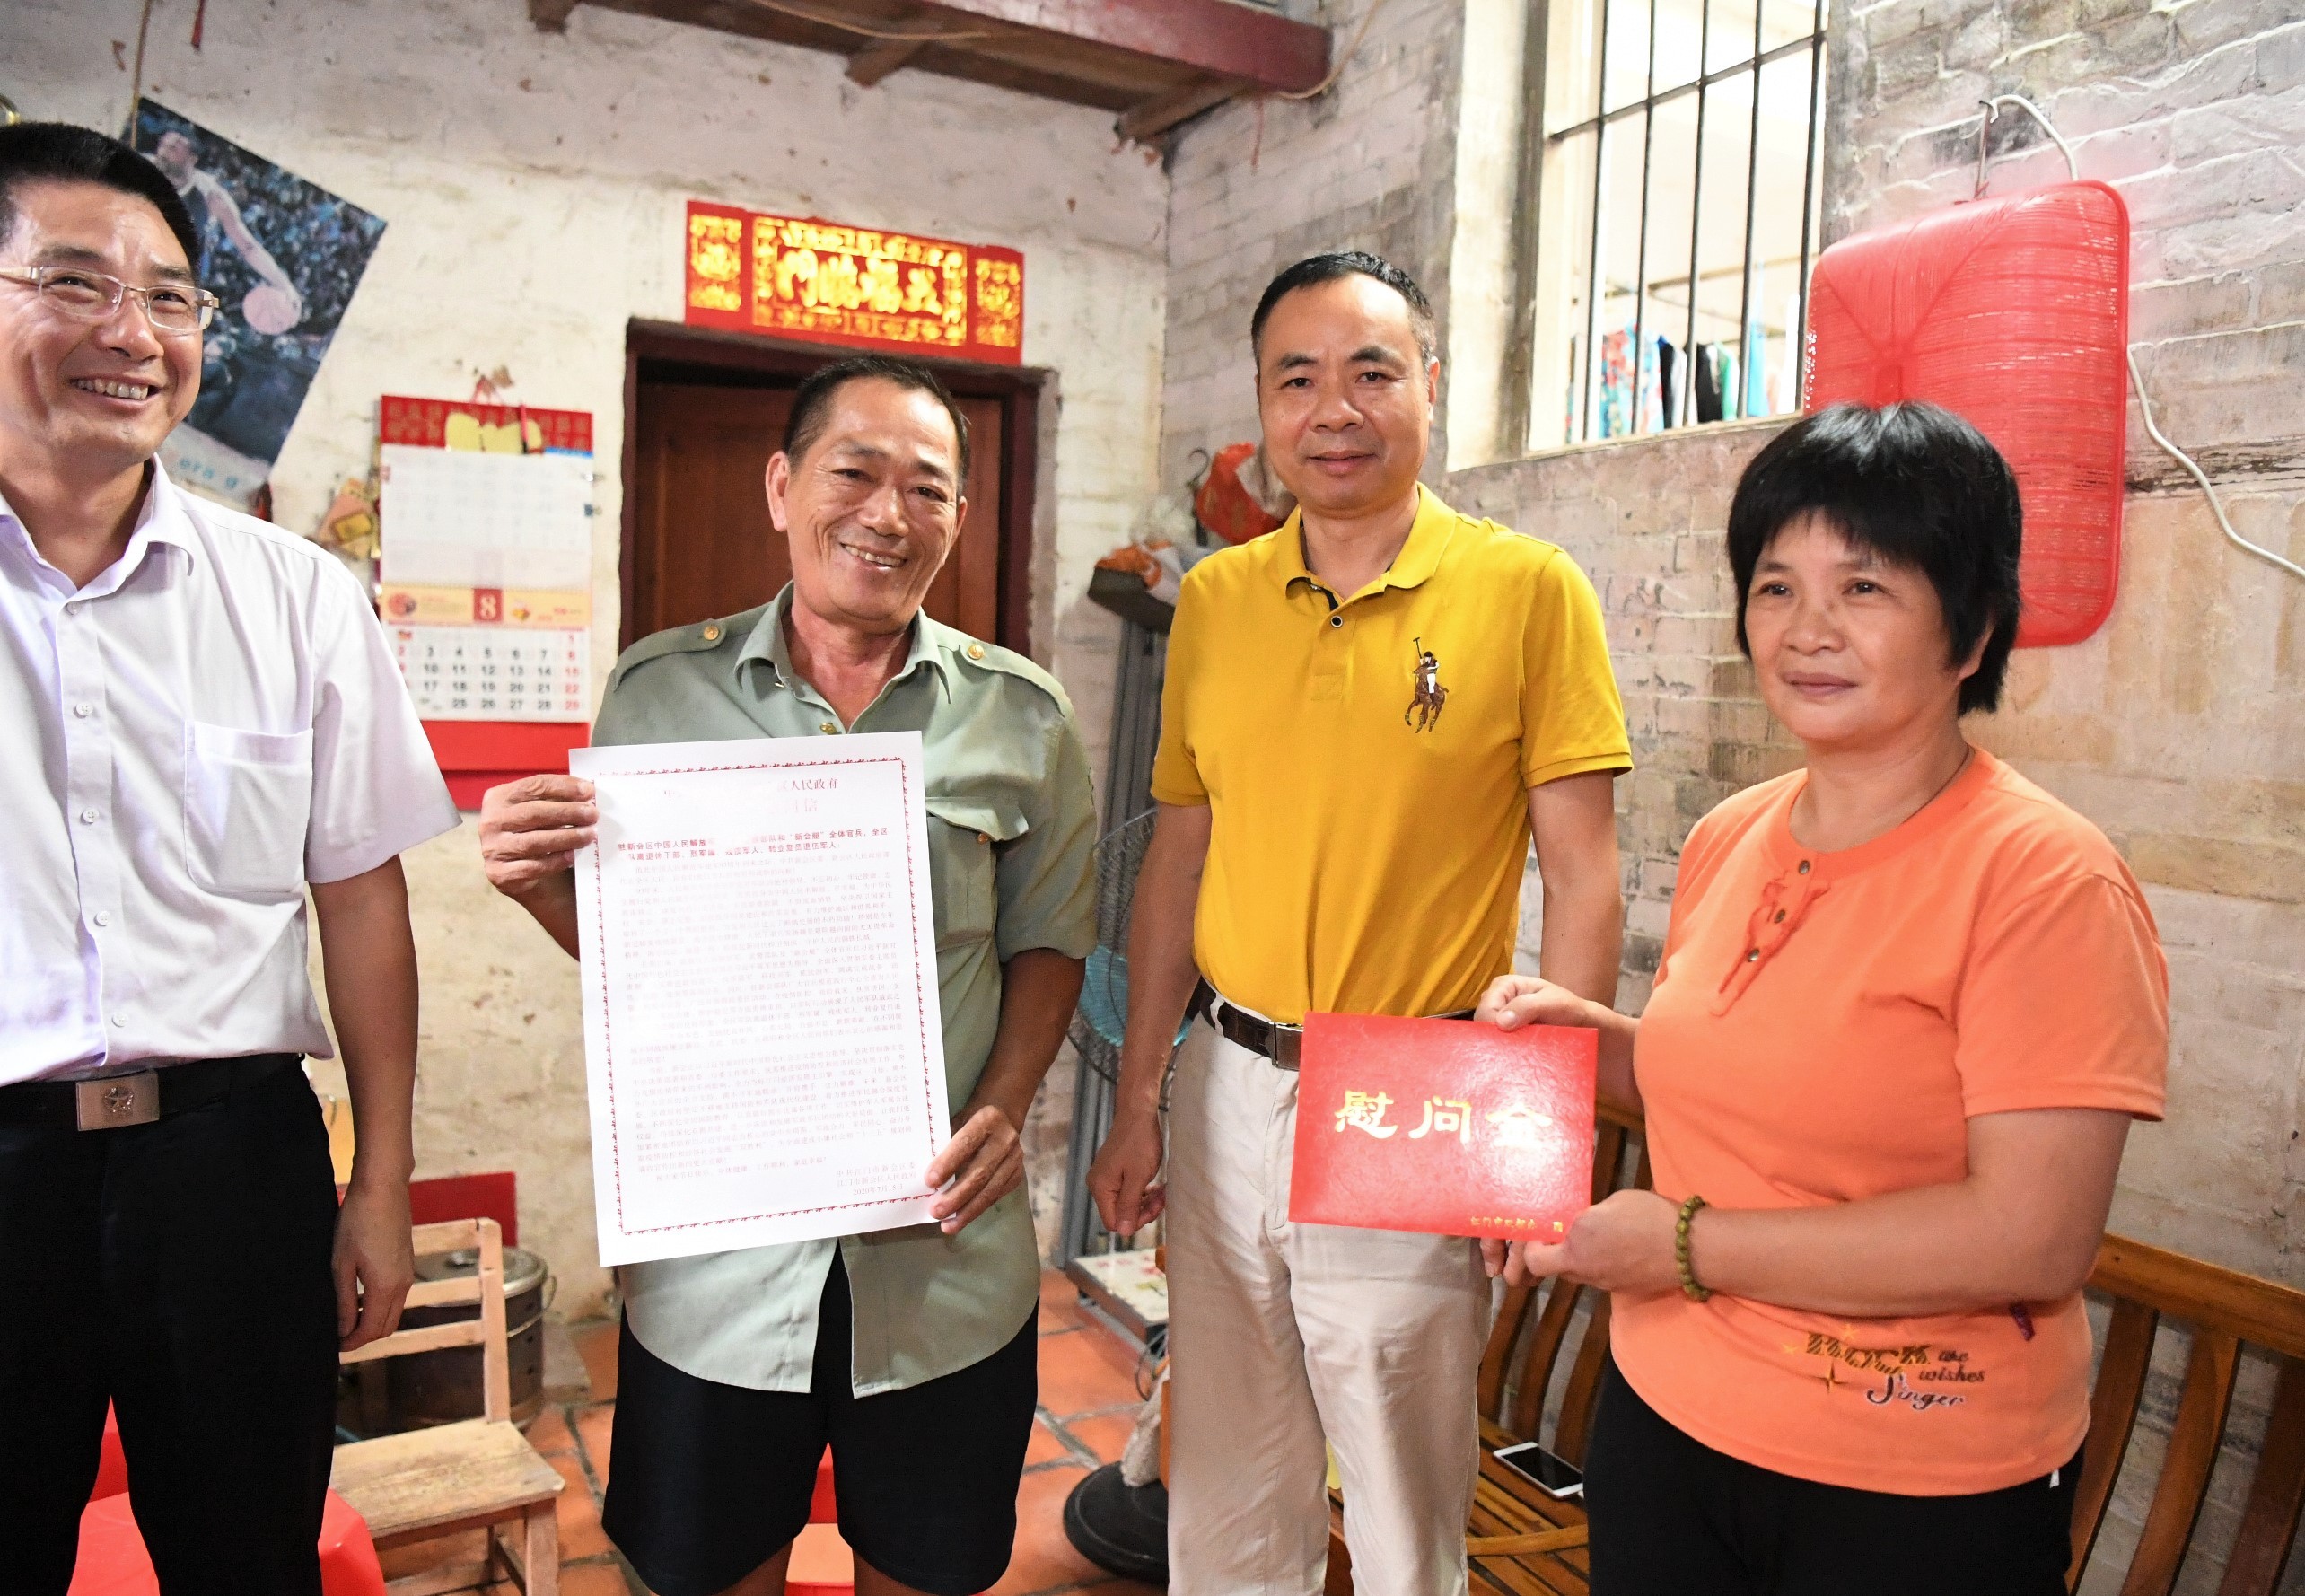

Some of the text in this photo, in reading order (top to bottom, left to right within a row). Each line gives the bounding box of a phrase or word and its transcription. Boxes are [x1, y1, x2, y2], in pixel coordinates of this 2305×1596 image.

[479, 594, 497, 620] 8
[790, 777, 839, 791] 人民政府
[1335, 1089, 1554, 1149] 慰问金
[1919, 1365, 1985, 1383] wishes
